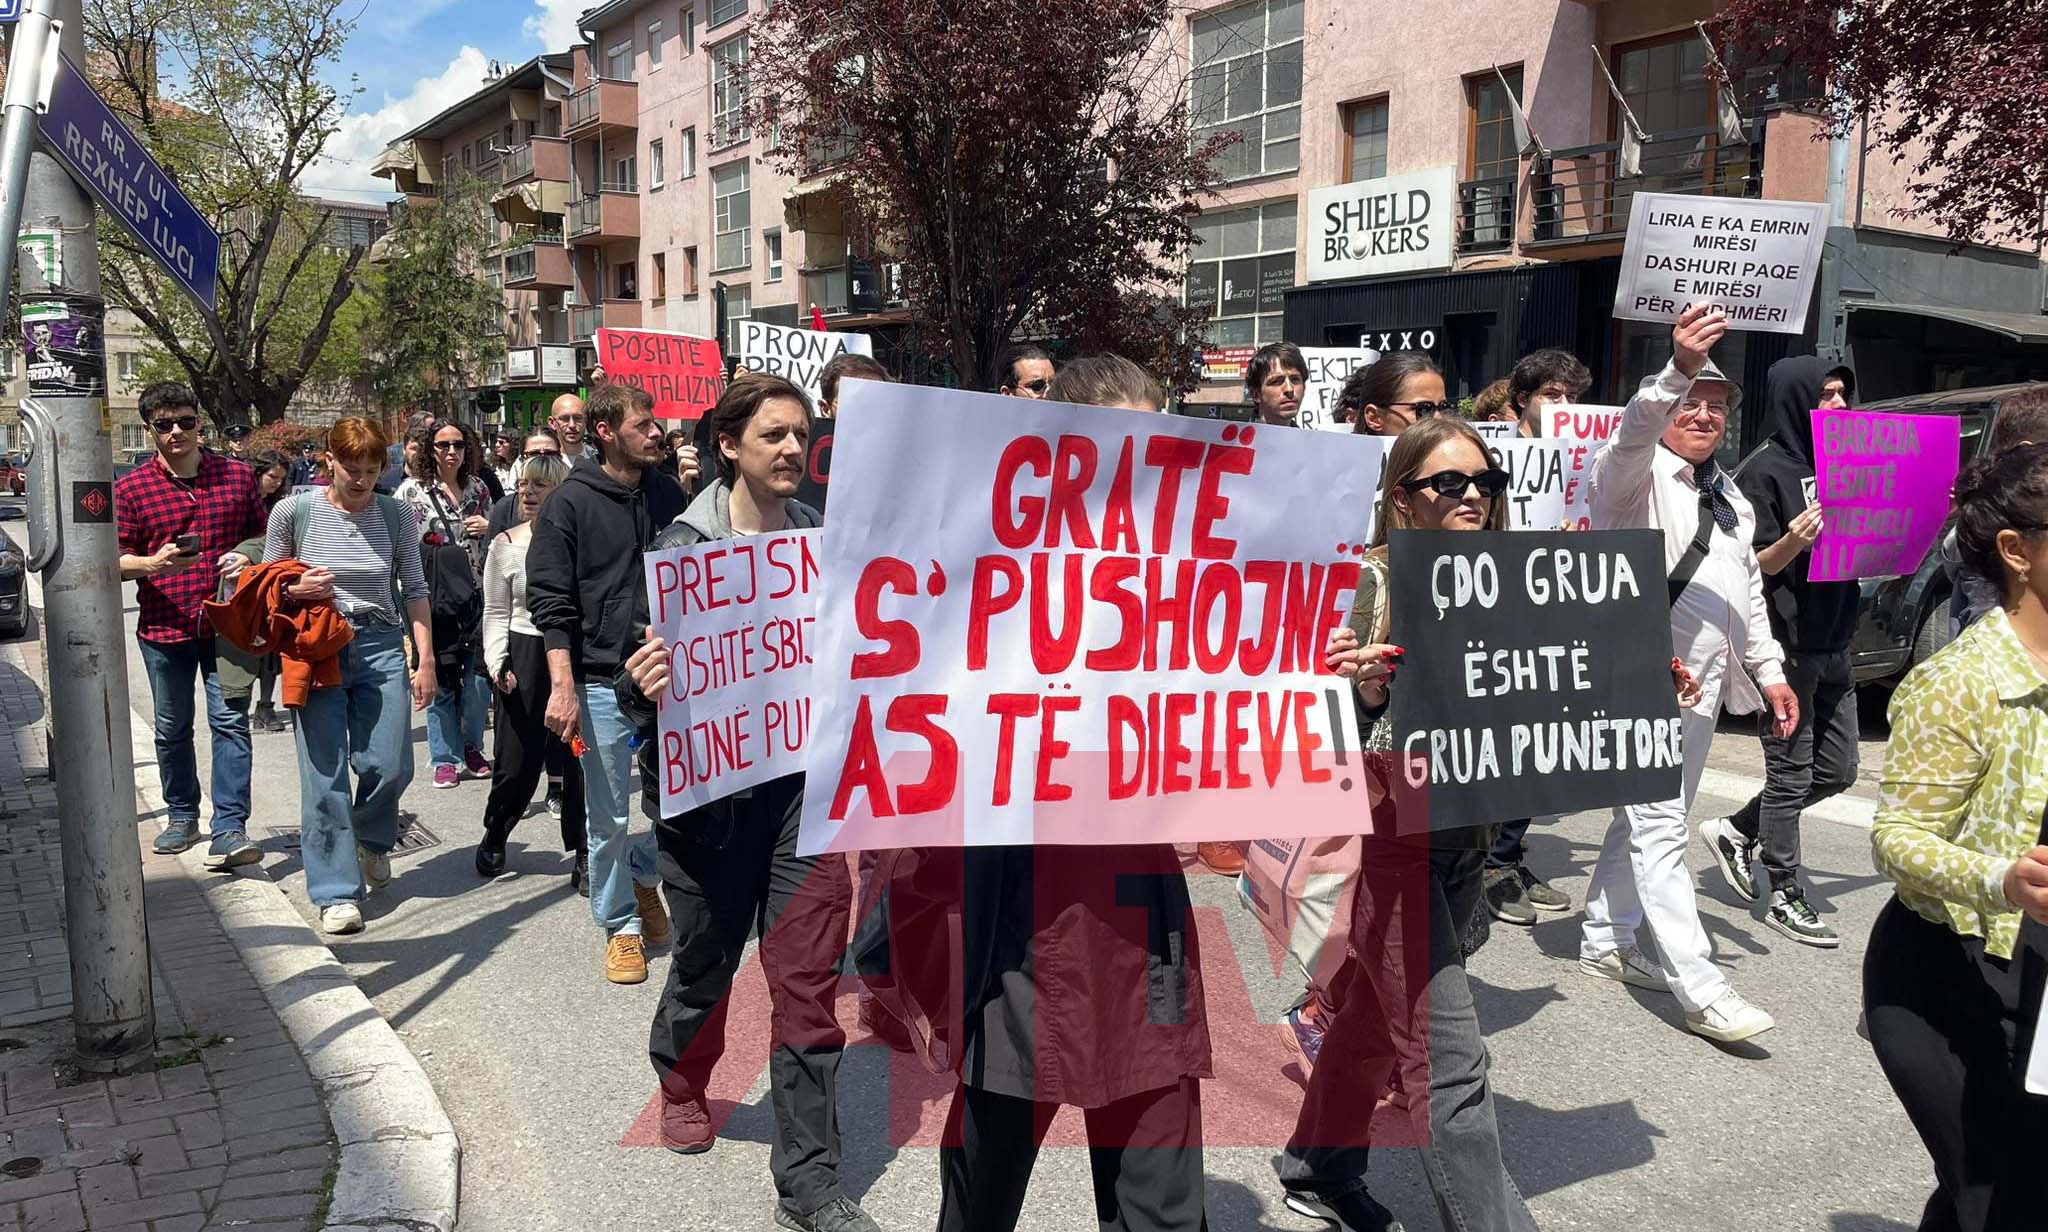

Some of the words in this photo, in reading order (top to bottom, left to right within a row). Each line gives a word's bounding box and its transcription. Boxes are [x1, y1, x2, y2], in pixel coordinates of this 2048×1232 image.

[101, 120, 129, 169] RR.
[150, 173, 173, 219] UL.
[64, 120, 149, 224] REXHEP
[153, 216, 194, 280] LUCI
[1324, 189, 1431, 237] SHIELD
[1648, 211, 1695, 229] LIRIA
[1701, 215, 1713, 230] E
[1718, 217, 1744, 232] KA
[1750, 219, 1810, 236] EMRIN
[1323, 224, 1430, 263] BROKERS
[1644, 254, 1737, 277] DASHURI
[1742, 261, 1800, 281] PAQE
[1692, 234, 1757, 253] MIRËSI
[1634, 295, 1675, 314] PËR
[1680, 302, 1788, 323] ADHMËRI
[1673, 278, 1687, 294] E
[1692, 279, 1762, 299] MIRËSI
[607, 333, 705, 367] POSHTË
[746, 325, 849, 362] PRONA
[1360, 330, 1435, 351] EXXO
[991, 423, 1255, 560] GRATË
[656, 545, 756, 624] PREJ
[1431, 551, 1499, 620] ÇDO
[1525, 548, 1641, 605] GRUA
[660, 620, 755, 711] OSHTË
[1464, 639, 1592, 698] ËSHTË
[664, 703, 753, 796] BIJNË
[827, 693, 958, 821] AS
[986, 682, 1082, 806] TË
[1106, 689, 1354, 800] DIELEVE!
[1404, 727, 1502, 790] GRUA
[1510, 710, 1682, 777] PUNËTORE
